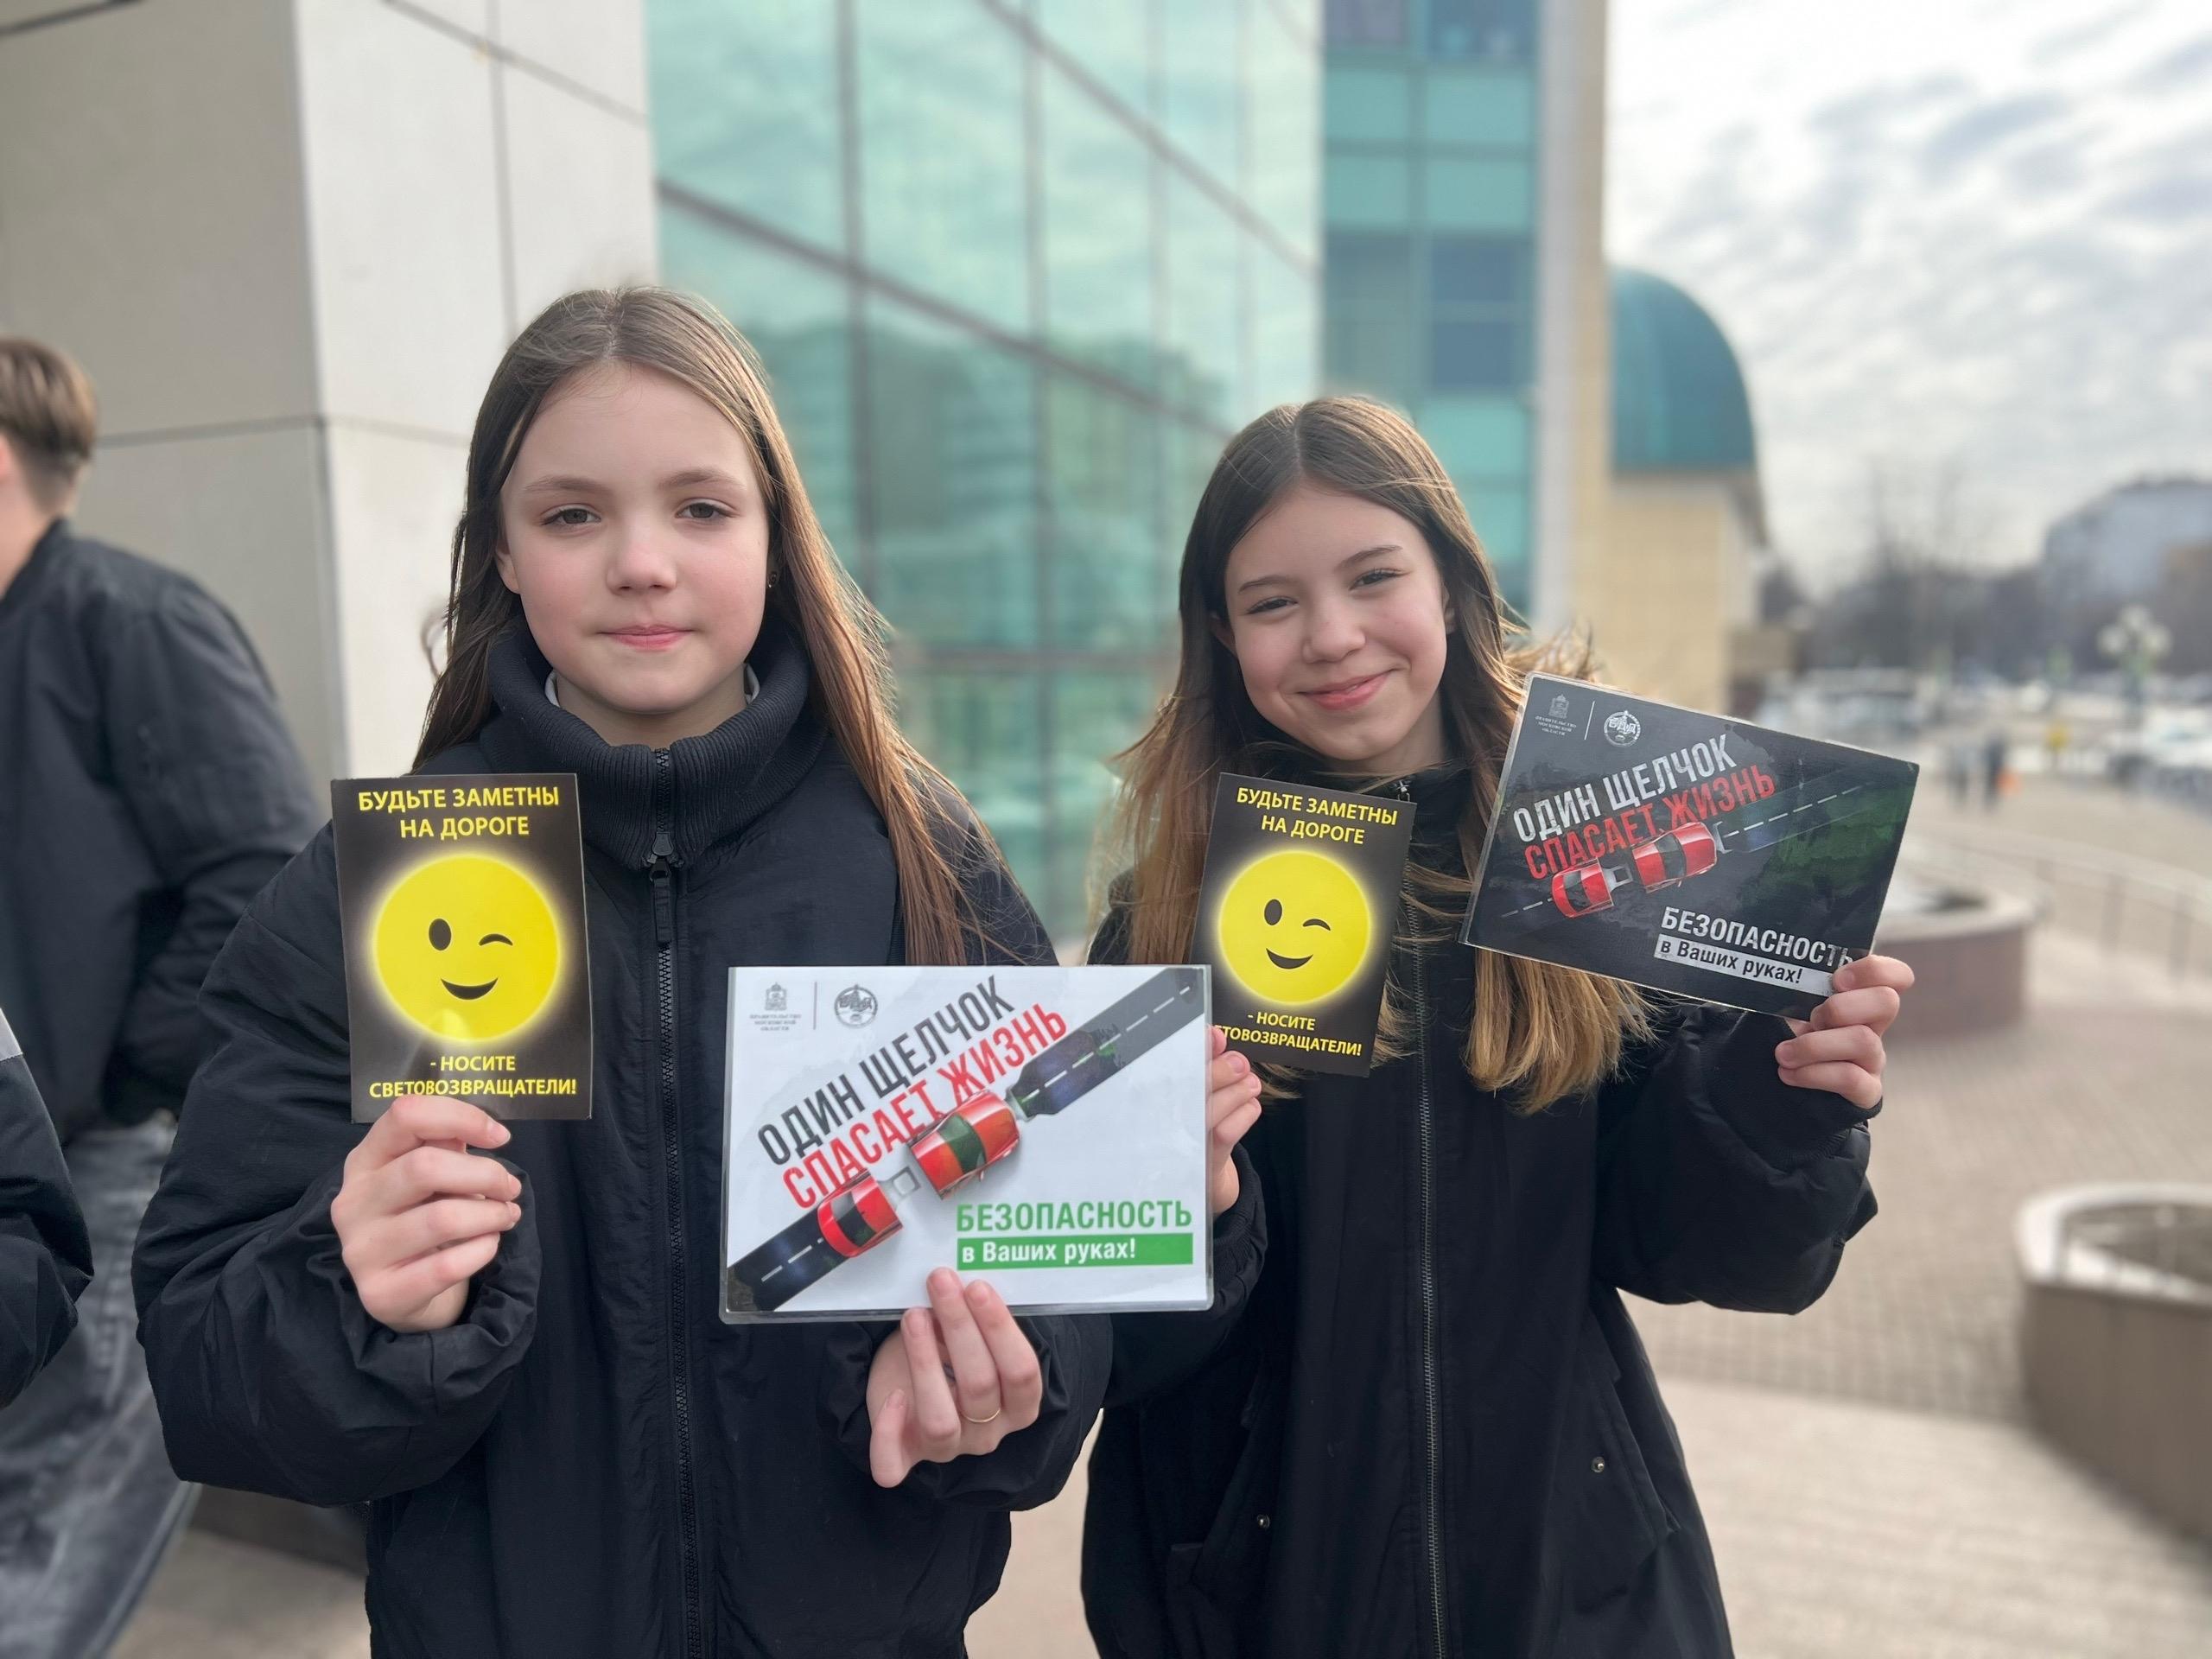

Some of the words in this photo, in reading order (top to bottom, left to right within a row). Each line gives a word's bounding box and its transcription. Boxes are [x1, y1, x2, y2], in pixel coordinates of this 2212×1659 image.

[359, 789, 447, 813] БУДЬТЕ
[452, 786, 560, 808] ЗАМЕТНЫ
[1513, 783, 1607, 843] ОДИН
[1603, 734, 1737, 811] ЩЕЛЧОК
[1236, 787, 1303, 811] БУДЬТЕ
[1306, 797, 1398, 826] ЗАМЕТНЫ
[1524, 803, 1663, 880] СПАСАЕТ
[1662, 765, 1777, 830] ЖИЗНЬ
[399, 819, 434, 838] НА
[440, 816, 530, 840] ДОРОГЕ
[1261, 815, 1287, 833] НА
[1290, 818, 1366, 845] ДОРОГЕ
[1660, 941, 1671, 955] в
[1676, 940, 1738, 970] Ваших
[1741, 954, 1804, 984] руках!
[1256, 1011, 1316, 1031] НОСИТЕ
[1214, 1024, 1362, 1057] ТОВОЗВРАЩАТЕЛИ!
[440, 1055, 516, 1071] НОСИТЕ
[758, 1073, 866, 1166] ОДИН
[858, 975, 1015, 1098] ЩЕЛЧОК
[369, 1078, 577, 1098] СВЕТОВОЗВРАЩАТЕЛИ!
[782, 1079, 944, 1209] СПАСАЕТ
[936, 1002, 1068, 1108] ЖИЗНЬ
[956, 1200, 1192, 1232] БЕЗОПАСНОСТЬ
[962, 1249, 974, 1263] в
[982, 1242, 1057, 1263] Ваших
[1064, 1238, 1136, 1267] руках!
